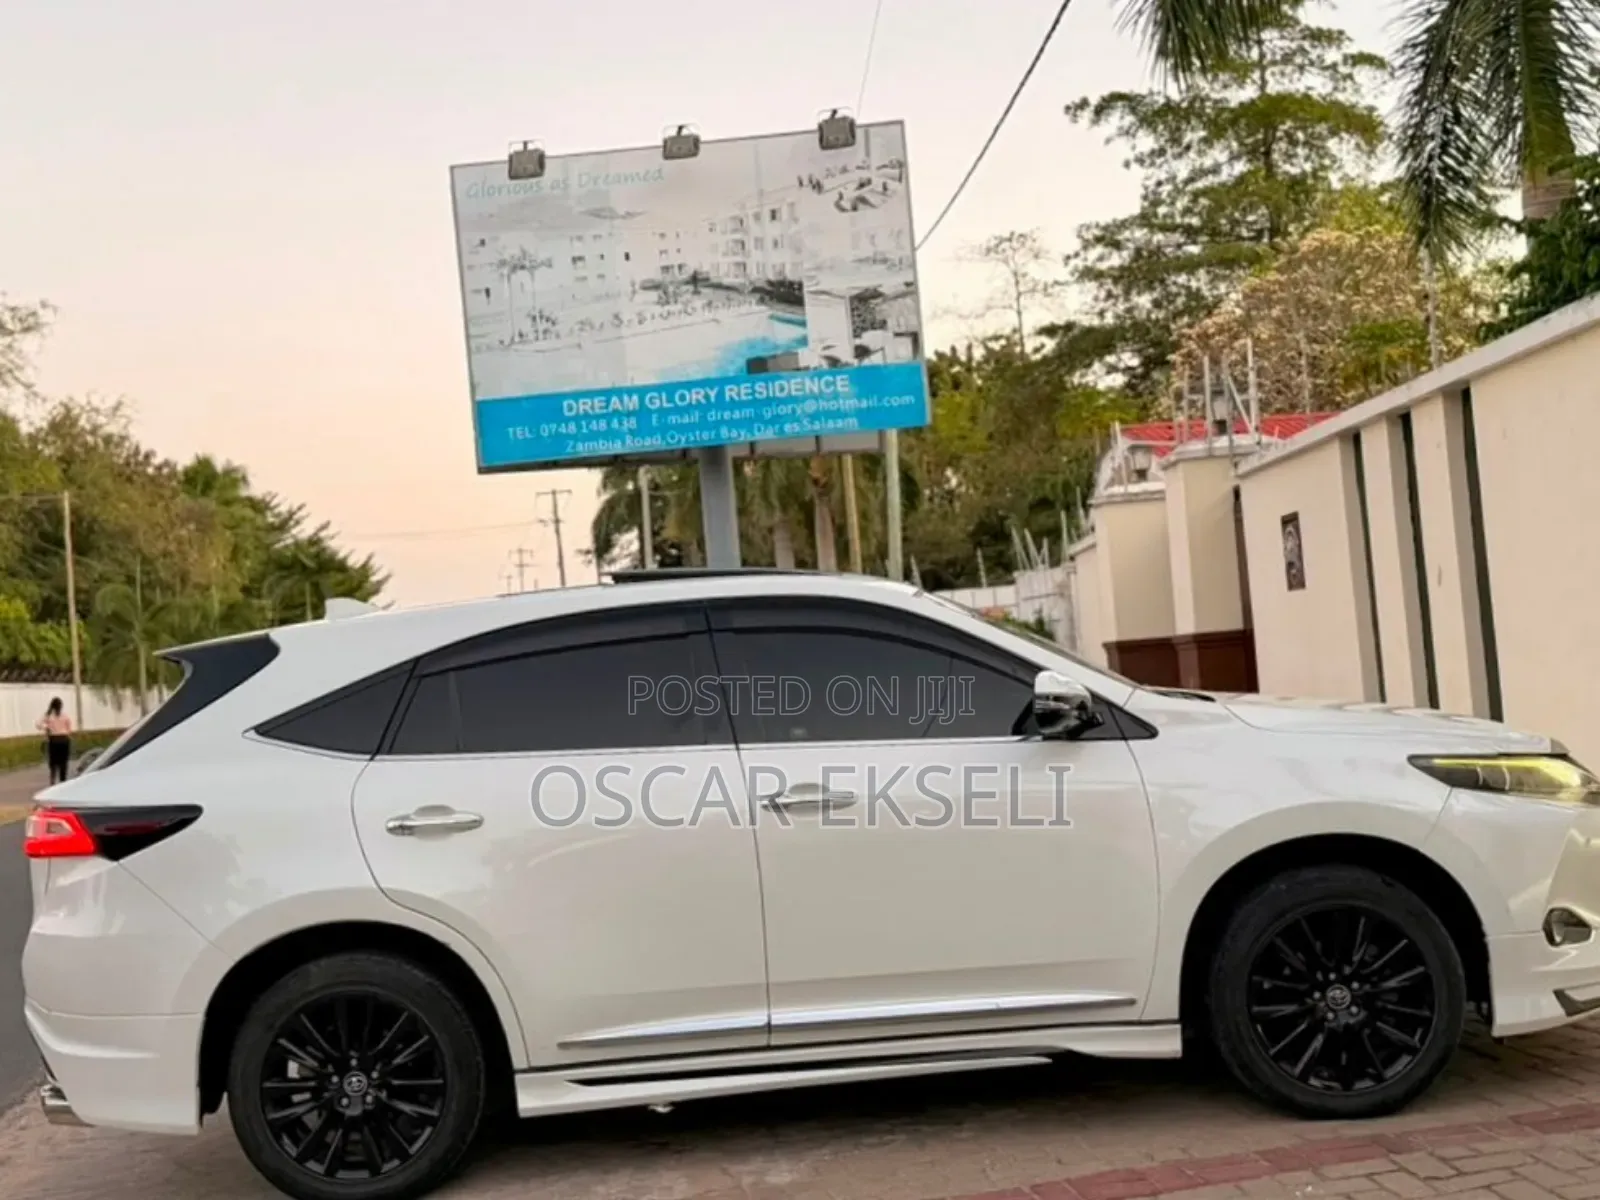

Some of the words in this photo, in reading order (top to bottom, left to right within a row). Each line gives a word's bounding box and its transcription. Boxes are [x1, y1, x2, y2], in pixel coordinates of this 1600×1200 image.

[466, 173, 544, 199] Glorious
[550, 178, 570, 192] as
[578, 167, 665, 189] Dreamed
[562, 394, 639, 417] DREAM
[645, 385, 718, 410] GLORY
[725, 374, 850, 402] RESIDENCE
[540, 421, 577, 438] 0748
[581, 418, 607, 434] 148
[565, 437, 622, 453] Zambia
[753, 421, 780, 437] Dar
[783, 421, 800, 434] es
[803, 414, 859, 431] Salaam
